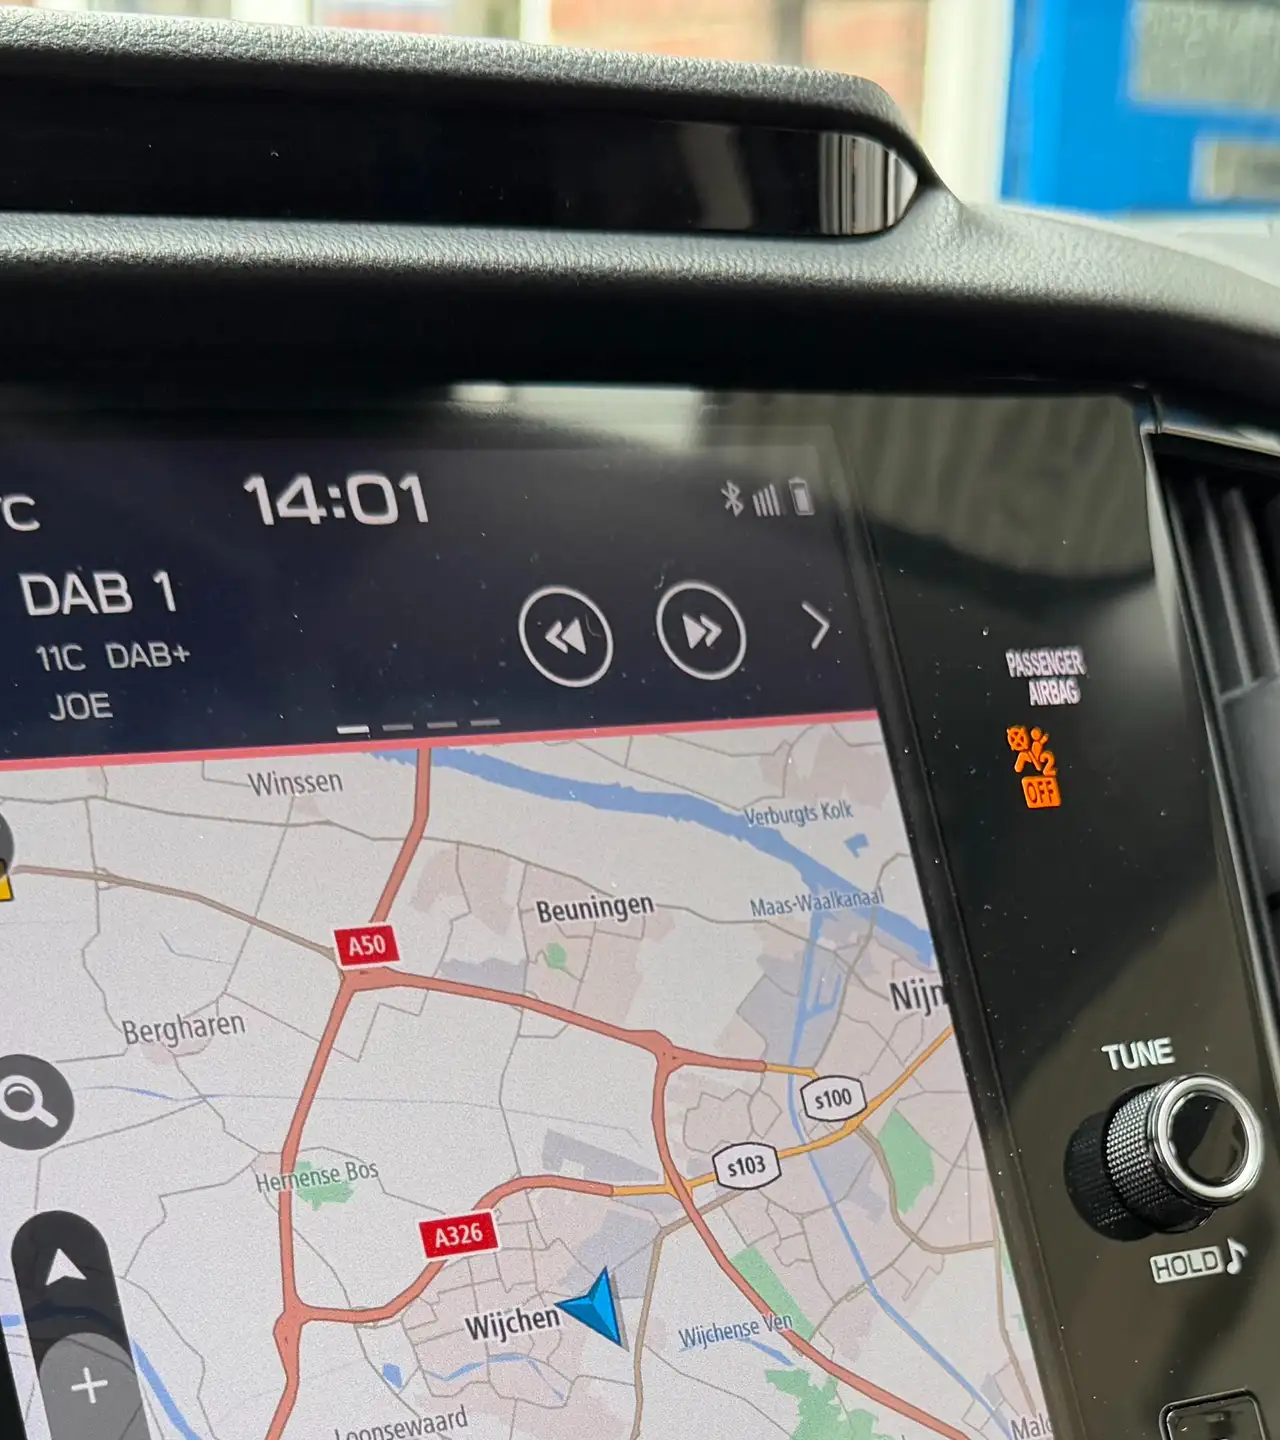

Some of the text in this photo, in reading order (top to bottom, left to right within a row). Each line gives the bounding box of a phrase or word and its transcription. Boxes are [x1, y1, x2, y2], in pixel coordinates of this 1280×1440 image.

[242, 471, 431, 527] 14:01
[20, 570, 178, 617] DAB 1
[35, 642, 192, 672] 11C DAB+
[1005, 646, 1087, 678] PASSENGER
[48, 692, 114, 721] JOE
[1028, 677, 1081, 706] AIRBAG
[246, 770, 345, 797] Winssen
[1025, 779, 1055, 805] OFF
[743, 799, 854, 828] Verburgts Kolk
[536, 894, 656, 924] Beuningen
[749, 886, 886, 917] Maas-Waalkanaal
[348, 935, 388, 958] A50
[122, 1013, 247, 1048] Bergharen
[1101, 1036, 1176, 1071] TUNE
[815, 1087, 853, 1111] s100
[346, 1160, 380, 1182] Bos
[726, 1155, 767, 1179] s103
[434, 1223, 484, 1248] A326
[1153, 1250, 1220, 1281] HOLD
[464, 1308, 561, 1343] Wijchen
[678, 1314, 793, 1350] Wijchense Ven
